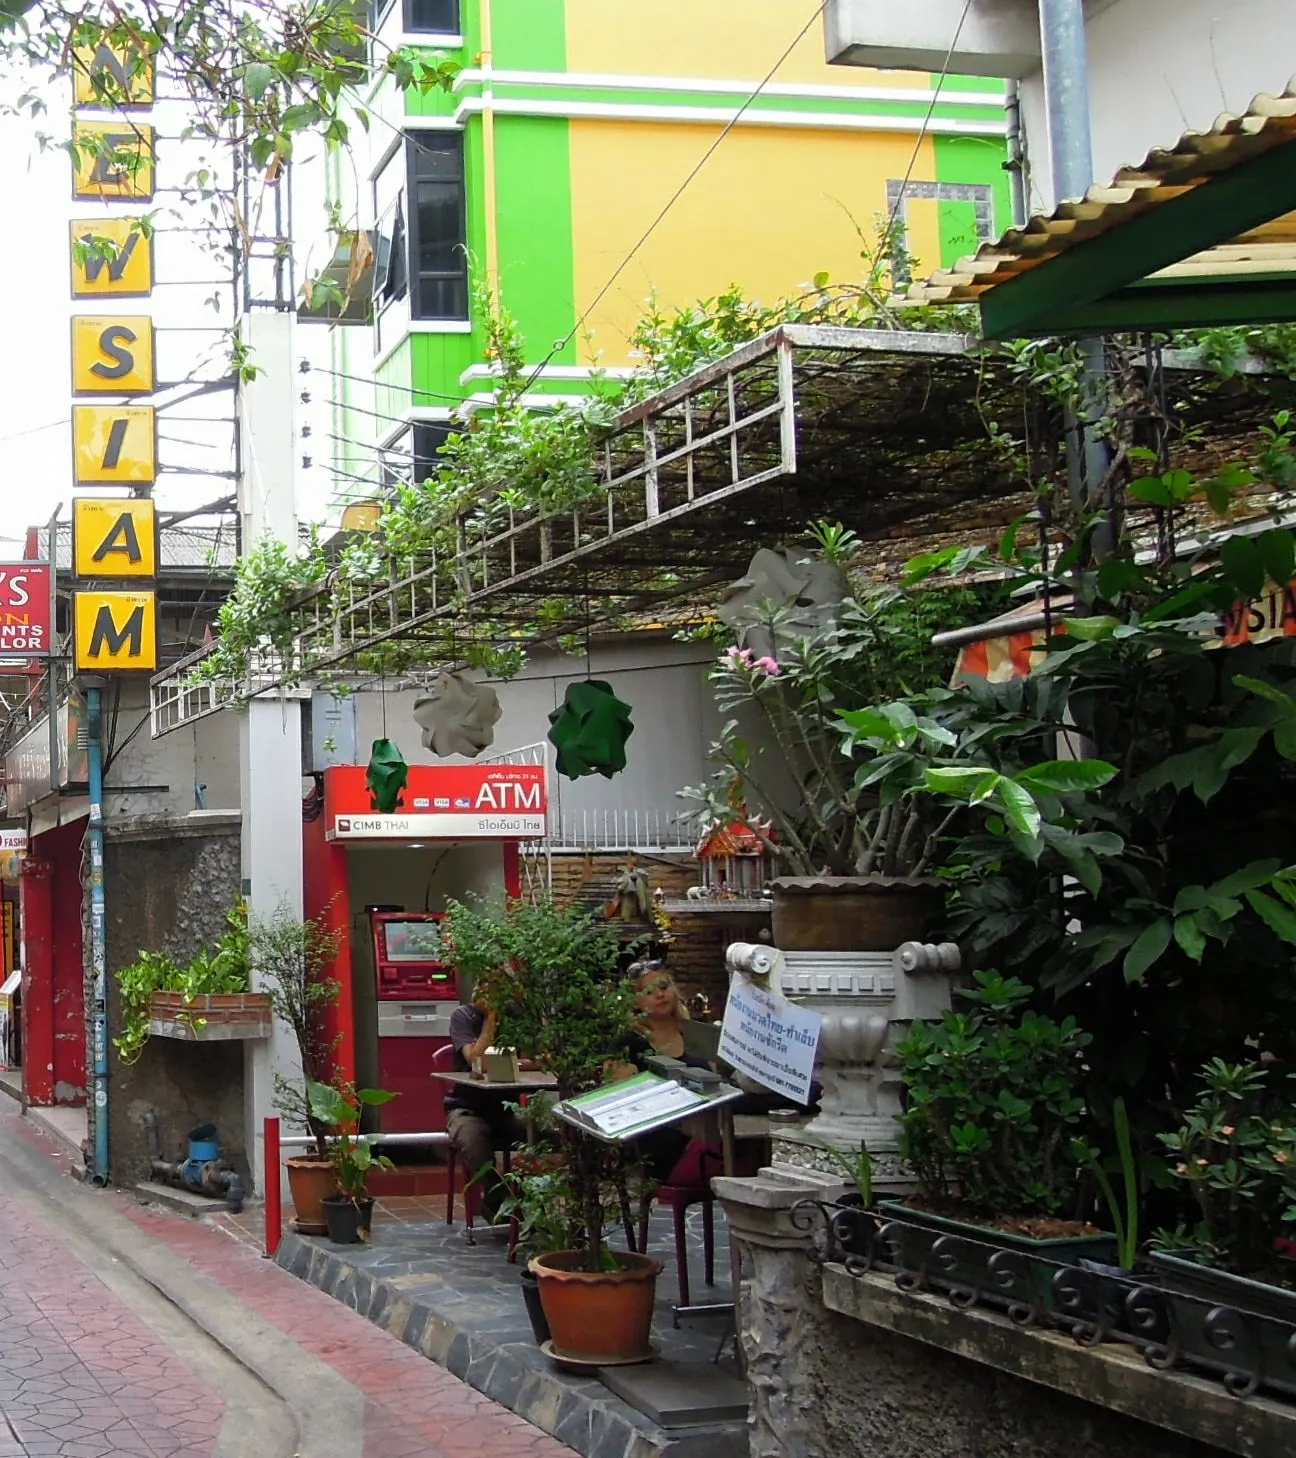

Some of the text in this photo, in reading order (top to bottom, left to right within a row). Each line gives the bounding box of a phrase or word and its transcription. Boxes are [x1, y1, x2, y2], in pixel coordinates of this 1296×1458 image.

[474, 782, 540, 809] ATM
[353, 821, 408, 830] CIMB THAI
[524, 818, 540, 830] ไทย
